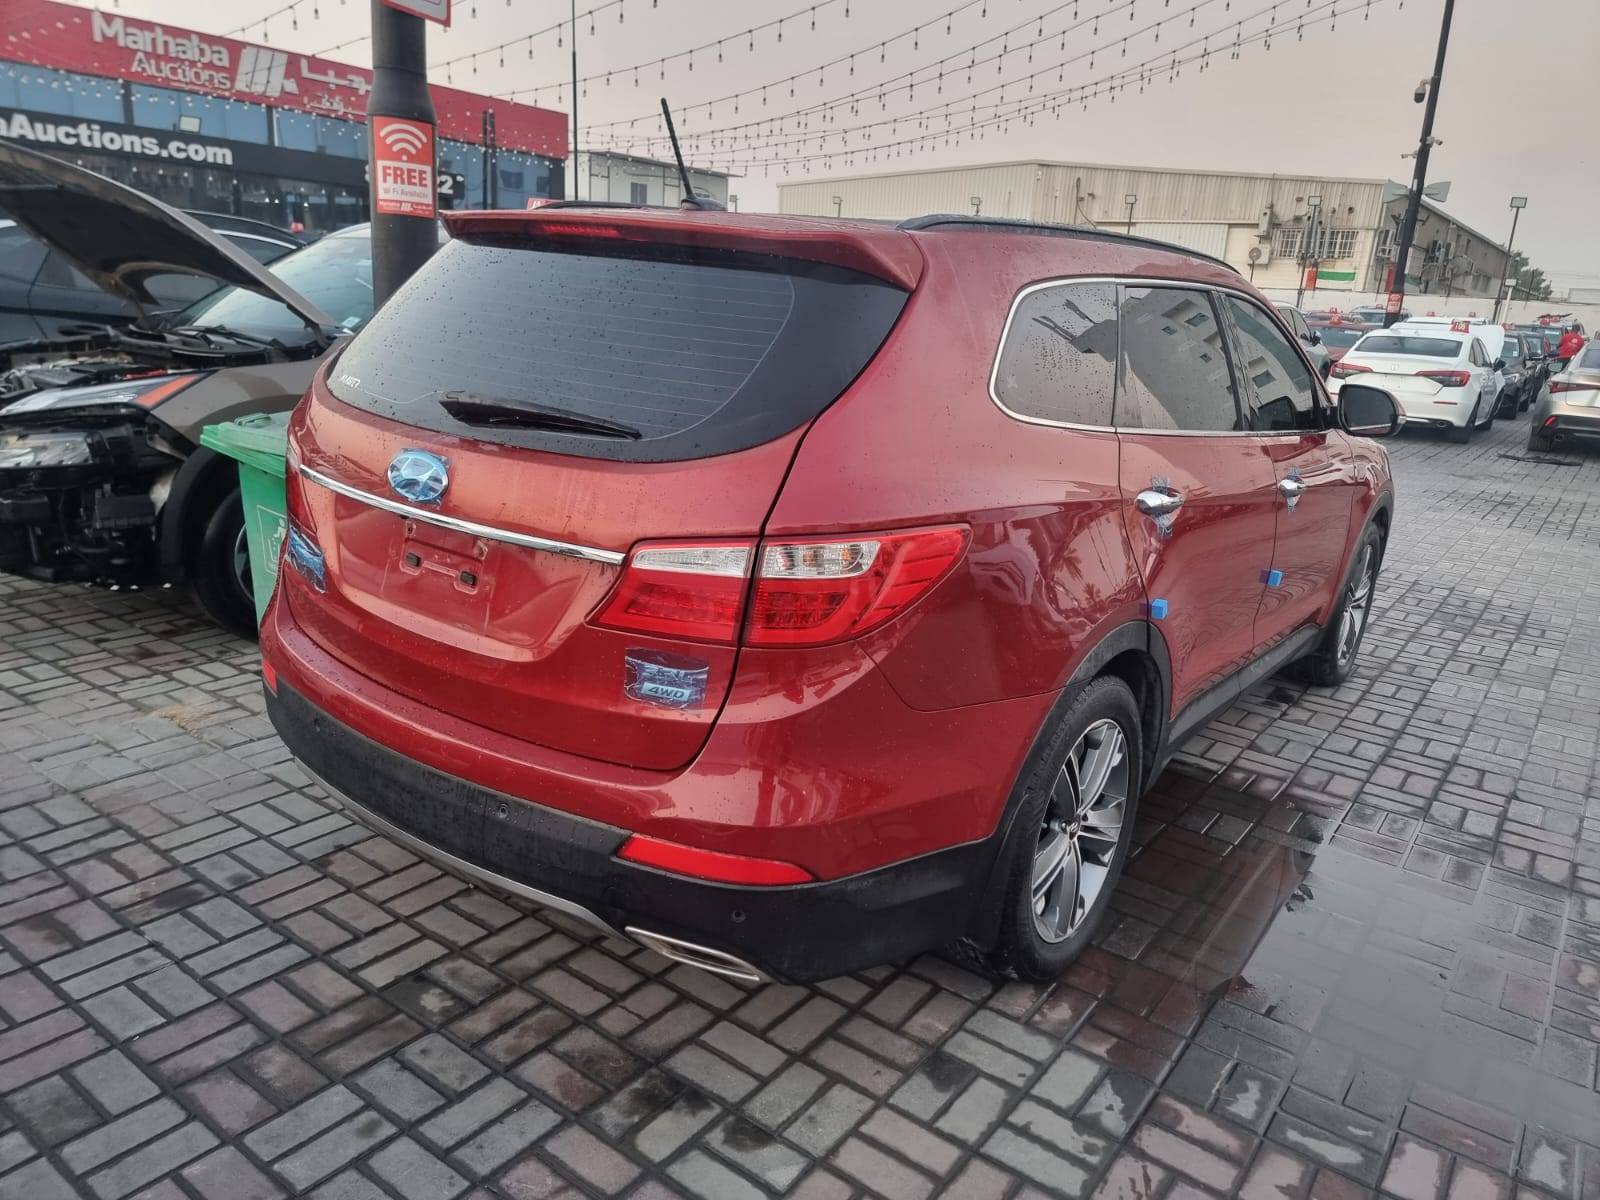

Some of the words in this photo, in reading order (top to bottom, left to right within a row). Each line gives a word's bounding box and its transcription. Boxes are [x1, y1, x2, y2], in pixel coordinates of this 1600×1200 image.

[91, 10, 229, 68] Marhaba
[131, 51, 231, 90] Auctions
[382, 165, 428, 188] FREE
[648, 685, 684, 699] 4WD
